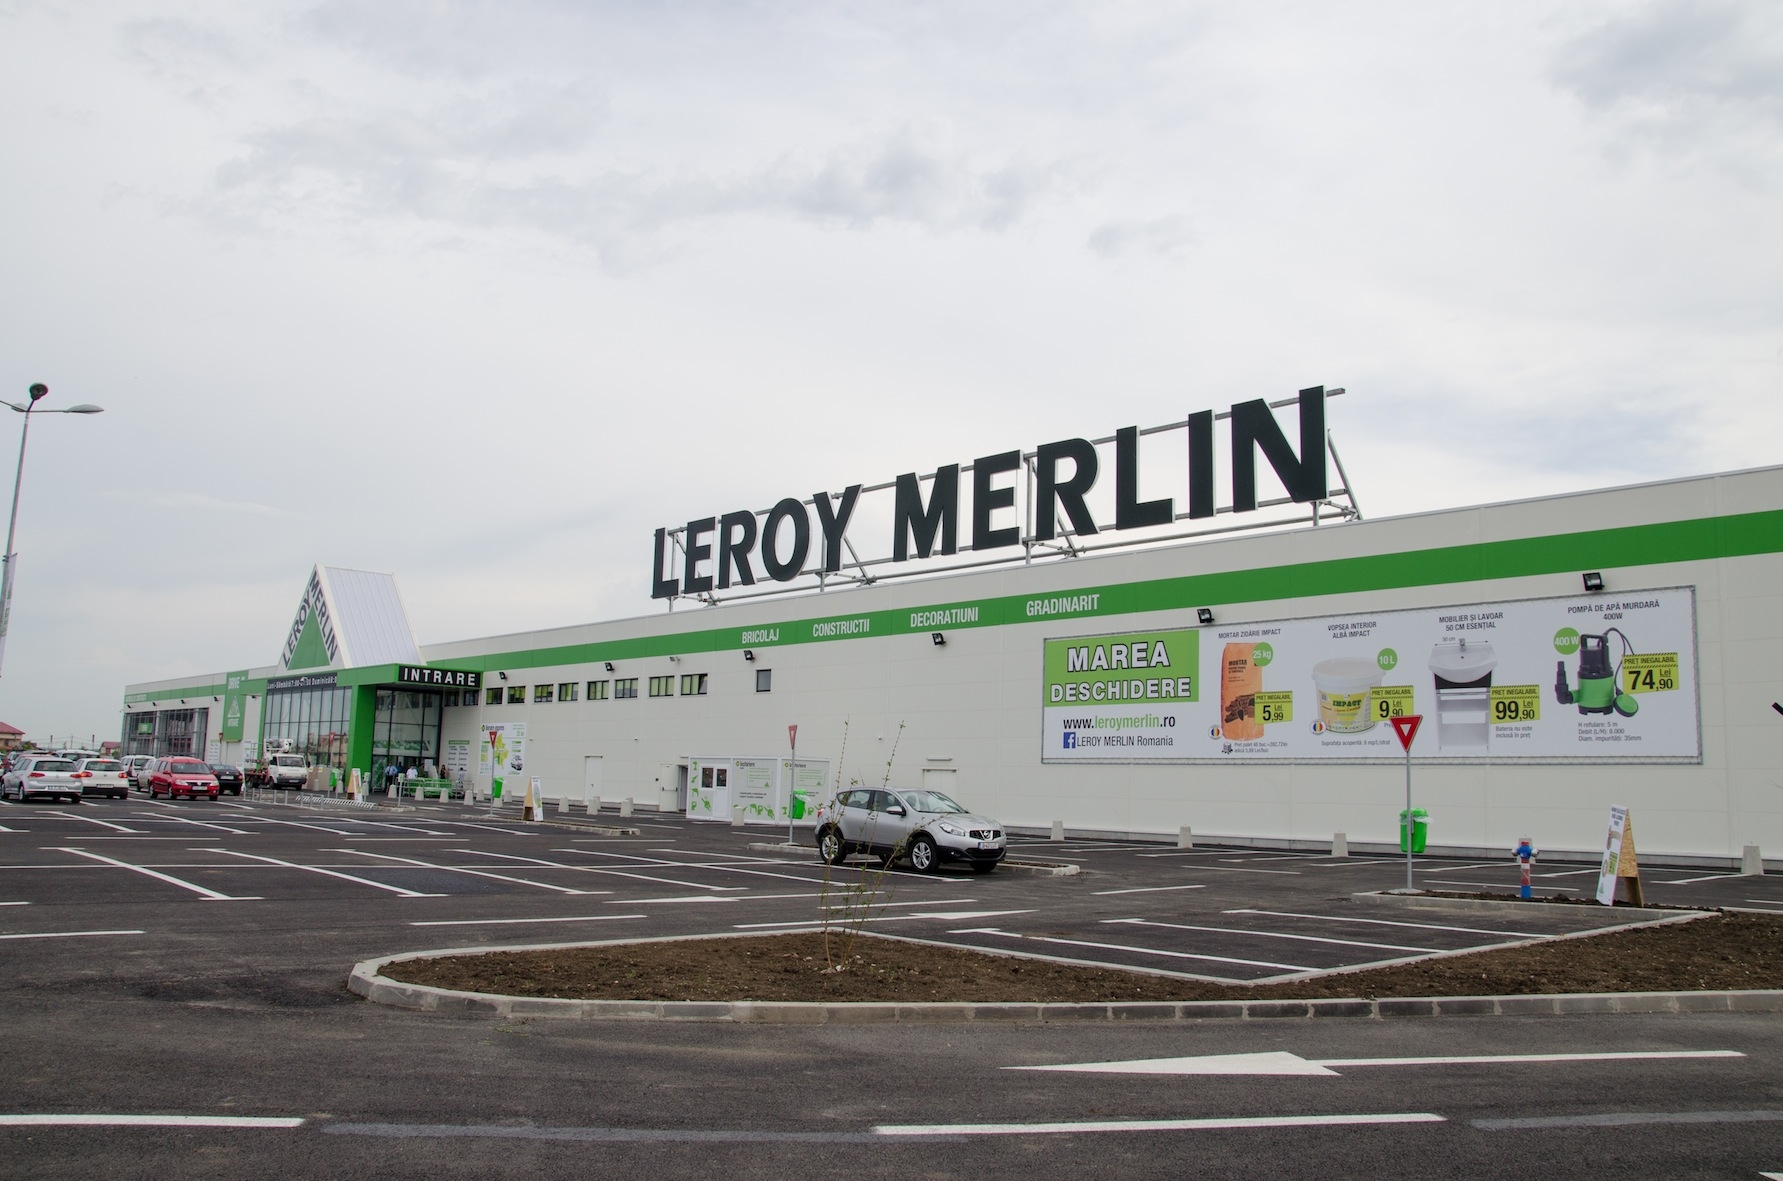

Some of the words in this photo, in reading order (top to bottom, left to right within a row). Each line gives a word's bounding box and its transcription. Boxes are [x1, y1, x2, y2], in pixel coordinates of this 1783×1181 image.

[652, 484, 864, 599] LEROY
[893, 385, 1328, 562] MERLIN
[1026, 594, 1100, 616] GRADINARIT
[309, 570, 338, 663] MERLIN
[910, 606, 979, 628] DECORATIUNI
[1439, 615, 1468, 623] MOBILIER
[1478, 612, 1503, 620] LAVOAR
[283, 588, 311, 668] LEROY
[813, 618, 870, 637] CONSTRUCTII
[1351, 622, 1377, 630] INTERIOR
[742, 629, 779, 644] BRICOLAJ
[1554, 638, 1570, 646] 400
[1571, 636, 1579, 644] W
[1067, 640, 1171, 673] MAREA
[1253, 650, 1261, 658] 25
[1263, 650, 1272, 659] kg
[1380, 656, 1388, 664] 10
[1390, 656, 1395, 664] L
[404, 668, 476, 686] INTRARE
[1660, 669, 1670, 677] Lei
[1050, 676, 1191, 702] DESCHIDERE
[1523, 700, 1533, 708] Lei
[1063, 714, 1176, 731] www.leroymerlin.ro
[1077, 736, 1102, 746] LEROY
[1104, 736, 1134, 746] MERLIN
[1137, 736, 1173, 746] Romania
